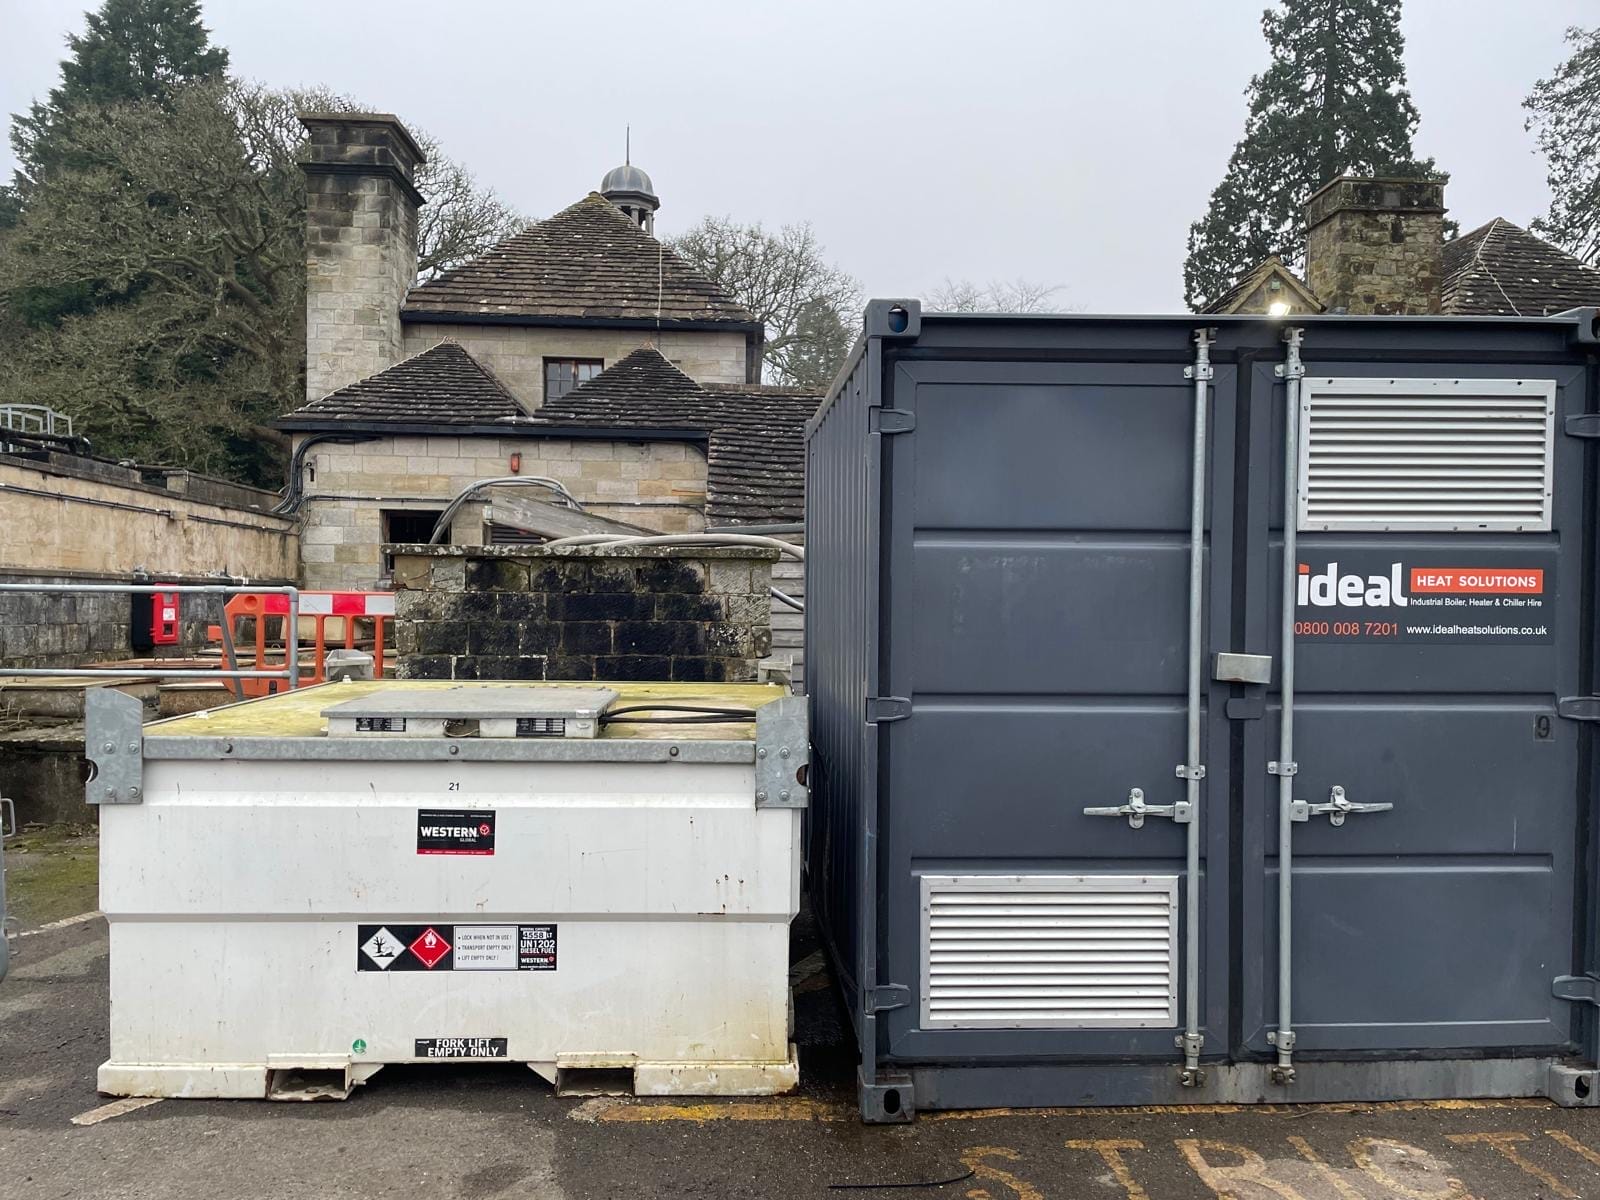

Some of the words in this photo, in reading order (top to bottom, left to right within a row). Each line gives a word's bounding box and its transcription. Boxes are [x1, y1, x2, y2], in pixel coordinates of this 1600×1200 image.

[1298, 562, 1408, 607] ideal
[1417, 575, 1453, 587] HEAT
[1459, 575, 1537, 588] SOLUTIONS
[1410, 597, 1443, 606] Industrial
[1444, 597, 1468, 608] Boiler,
[1469, 598, 1493, 607] Heater
[1494, 598, 1501, 607] &
[1502, 598, 1526, 607] Chiller
[1527, 598, 1542, 607] Hire
[1294, 621, 1329, 636] 0800
[1333, 621, 1360, 636] 008
[1364, 622, 1399, 636] 7201
[1406, 623, 1548, 636] www.idealheatsolutions.co.uk
[1537, 715, 1551, 738] 9
[448, 782, 460, 792] 21
[420, 826, 478, 838] WESTERN
[523, 931, 545, 939] 4558
[520, 939, 556, 949] UN1202
[436, 1038, 465, 1048] FORK
[468, 1038, 492, 1048] LIFT
[427, 1047, 467, 1057] EMPTY
[470, 1047, 500, 1057] ONLY
